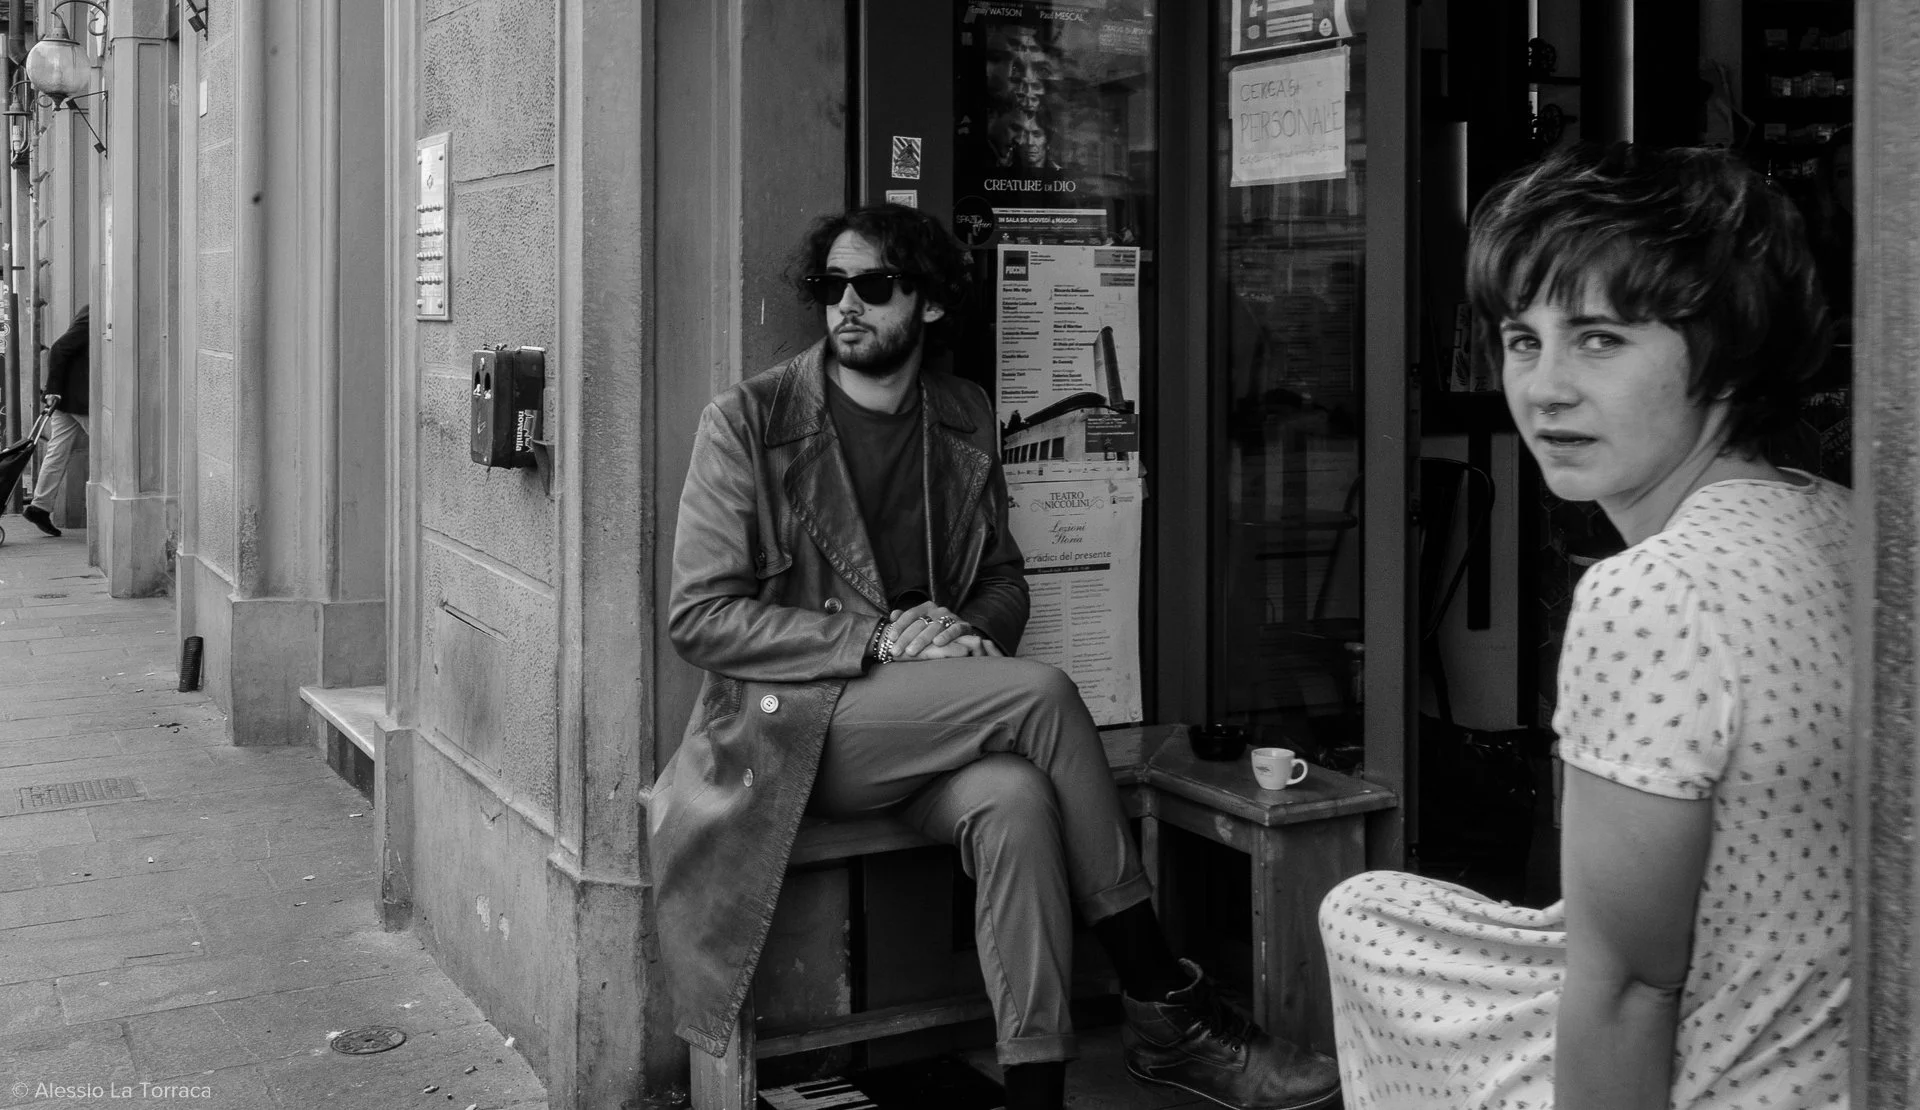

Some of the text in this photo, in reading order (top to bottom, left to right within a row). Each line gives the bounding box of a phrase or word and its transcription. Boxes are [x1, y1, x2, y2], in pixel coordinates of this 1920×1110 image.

[989, 7, 1023, 17] WATSON
[1054, 12, 1086, 22] MESCAL
[1240, 100, 1343, 143] PERSONALE
[984, 179, 1042, 192] CREATURE
[1054, 180, 1076, 192] DIO
[515, 411, 524, 451] novemila
[1050, 491, 1084, 501] TEATRO
[1044, 499, 1090, 509] NICCOLINI
[1050, 520, 1087, 533] Lezioni
[1032, 553, 1058, 562] radici
[1059, 551, 1073, 561] del
[1074, 550, 1112, 563] presente
